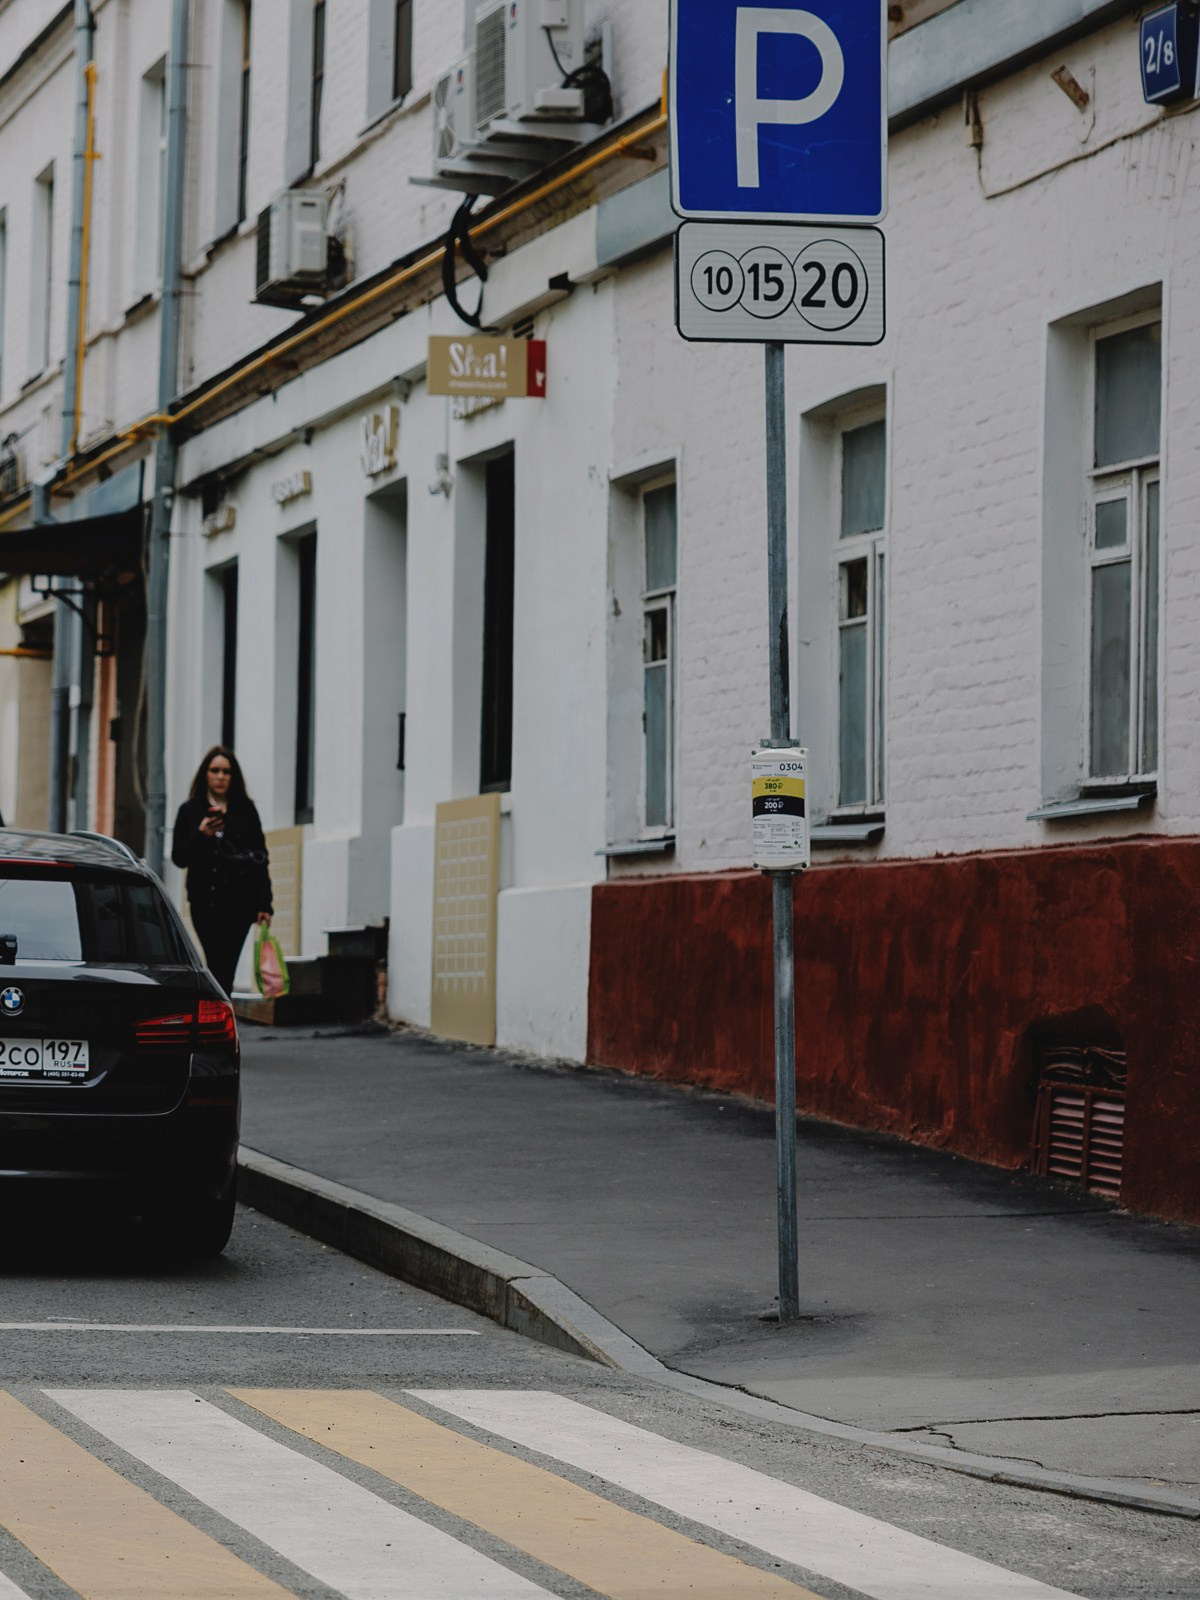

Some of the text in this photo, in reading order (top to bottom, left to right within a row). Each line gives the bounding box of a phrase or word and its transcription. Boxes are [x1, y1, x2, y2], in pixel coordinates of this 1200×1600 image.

[1144, 29, 1174, 74] 2/8
[734, 6, 845, 188] P
[703, 260, 859, 309] 10 15 20
[448, 341, 508, 379] Sha!
[779, 763, 803, 771] 0304
[764, 801, 778, 809] 200
[45, 1041, 83, 1062] 197
[53, 1060, 72, 1068] RUS
